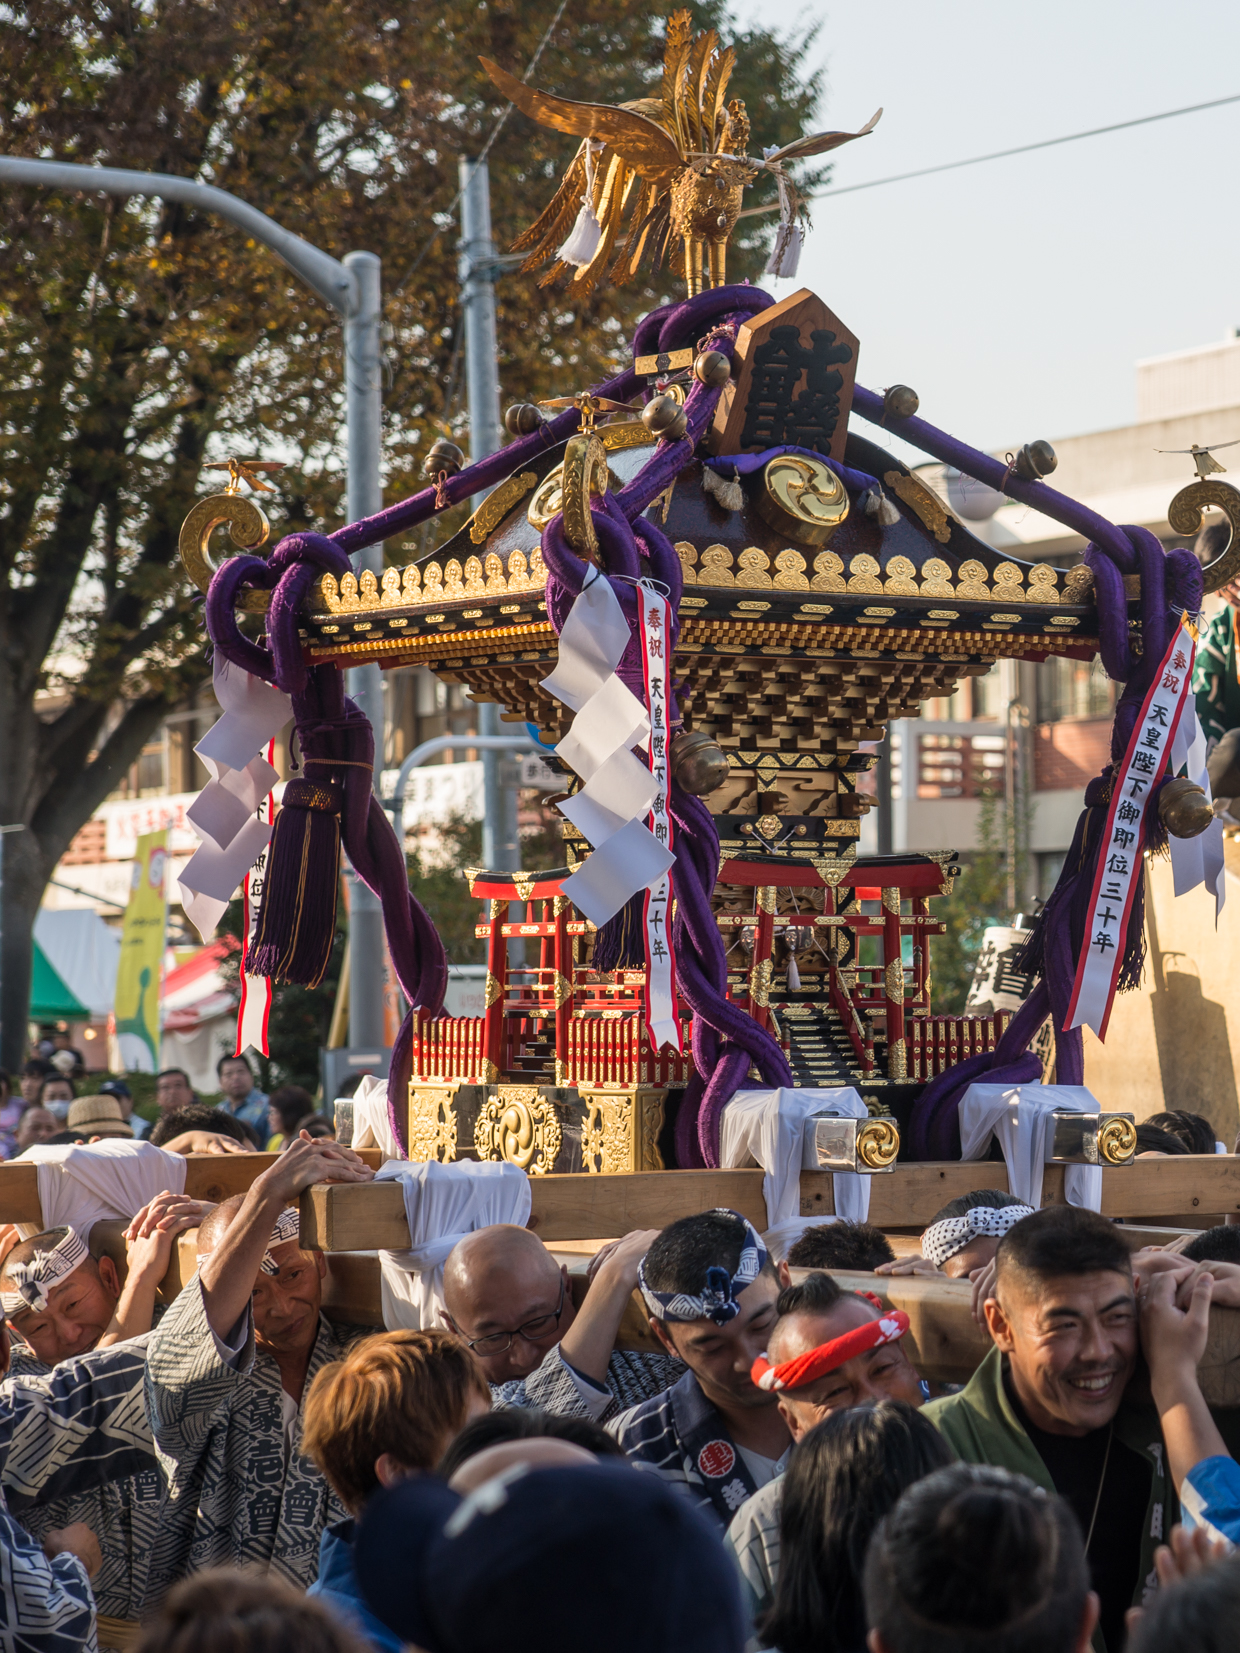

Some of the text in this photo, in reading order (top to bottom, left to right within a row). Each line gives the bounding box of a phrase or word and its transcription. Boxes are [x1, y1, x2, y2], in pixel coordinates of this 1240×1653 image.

[647, 606, 668, 963] 奉祝 天皇陛下御即三十年
[1092, 649, 1187, 954] 奉祝 天皇陛下御即位三十年
